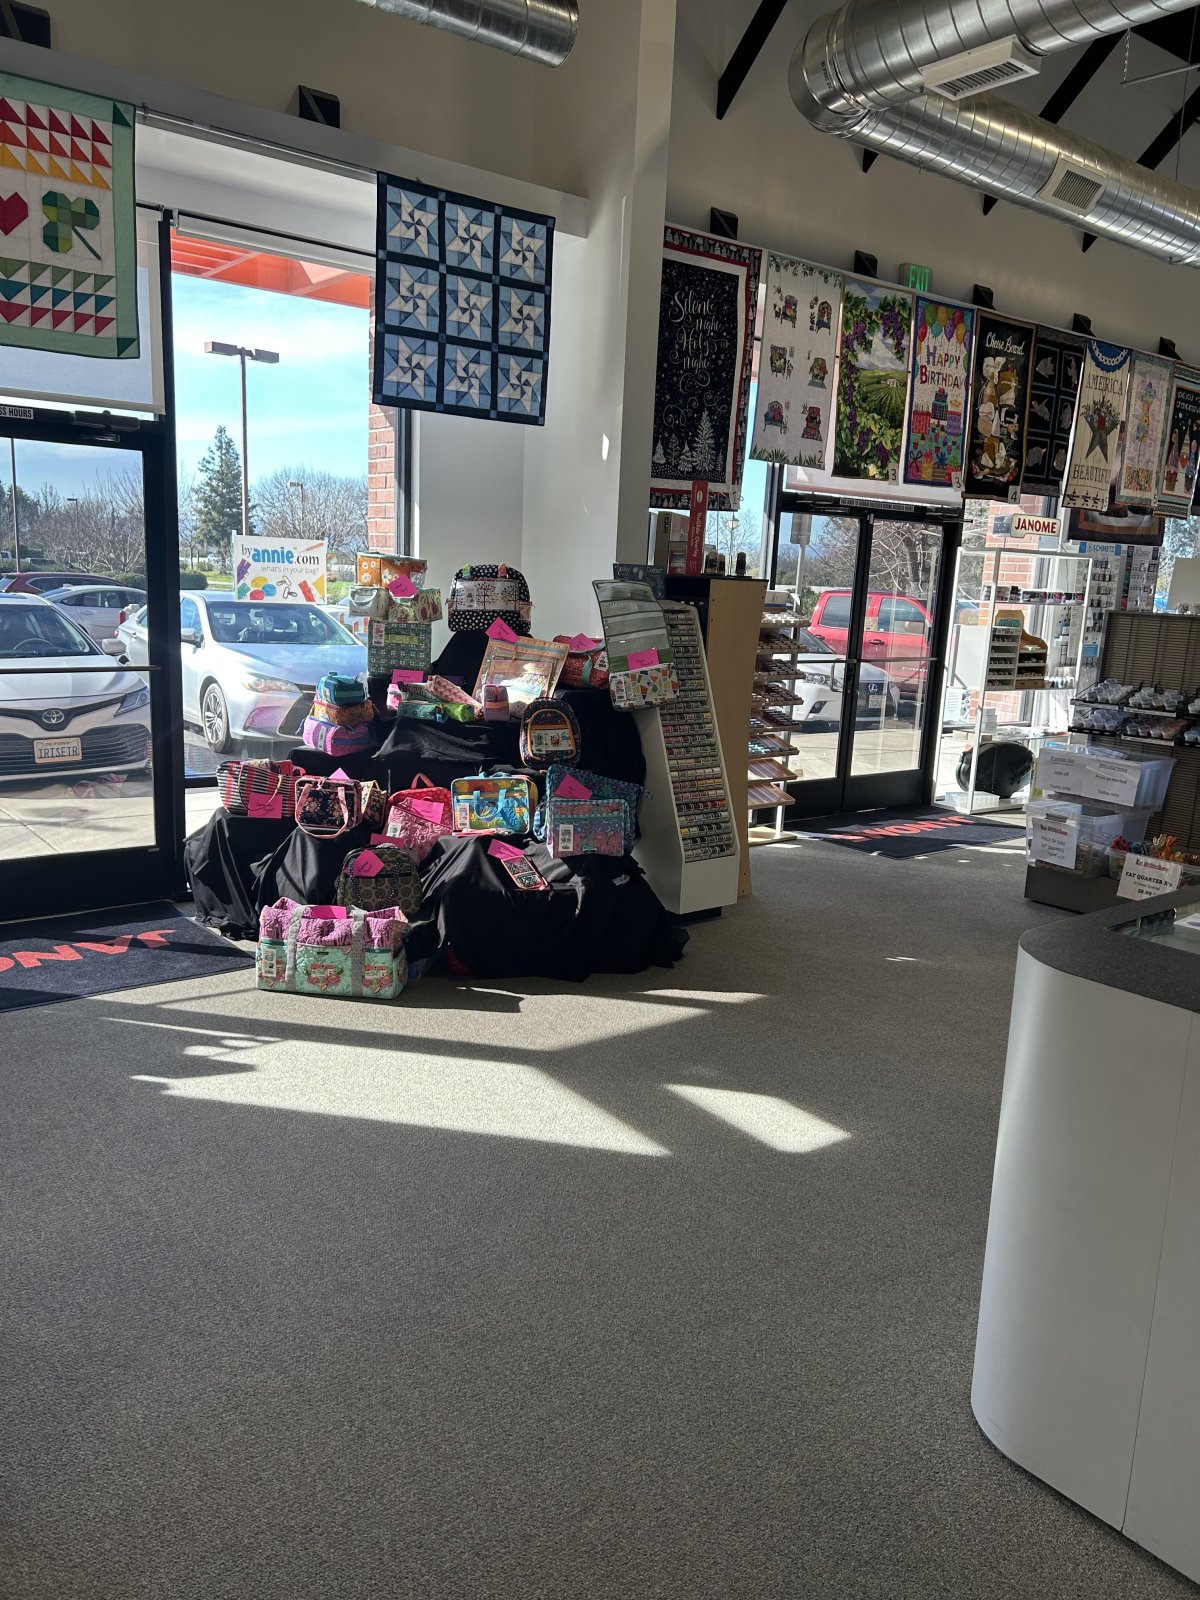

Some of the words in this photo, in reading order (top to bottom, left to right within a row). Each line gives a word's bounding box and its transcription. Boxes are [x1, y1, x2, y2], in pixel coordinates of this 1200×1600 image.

[908, 265, 930, 292] EXIT
[669, 290, 714, 323] Silent
[985, 331, 1005, 350] Cheese
[926, 344, 961, 369] HAPPY
[919, 364, 965, 389] BIRTHDAY
[1085, 374, 1123, 395] AMERICA
[8, 407, 32, 418] HOURS
[816, 450, 824, 464] 2
[890, 466, 897, 481] 3
[954, 476, 962, 490] 3
[1009, 488, 1018, 503] 4
[1015, 517, 1057, 534] JANOME
[1092, 545, 1115, 553] SCHMETZ
[289, 567, 304, 575] your
[1136, 874, 1163, 885] QUARTER
